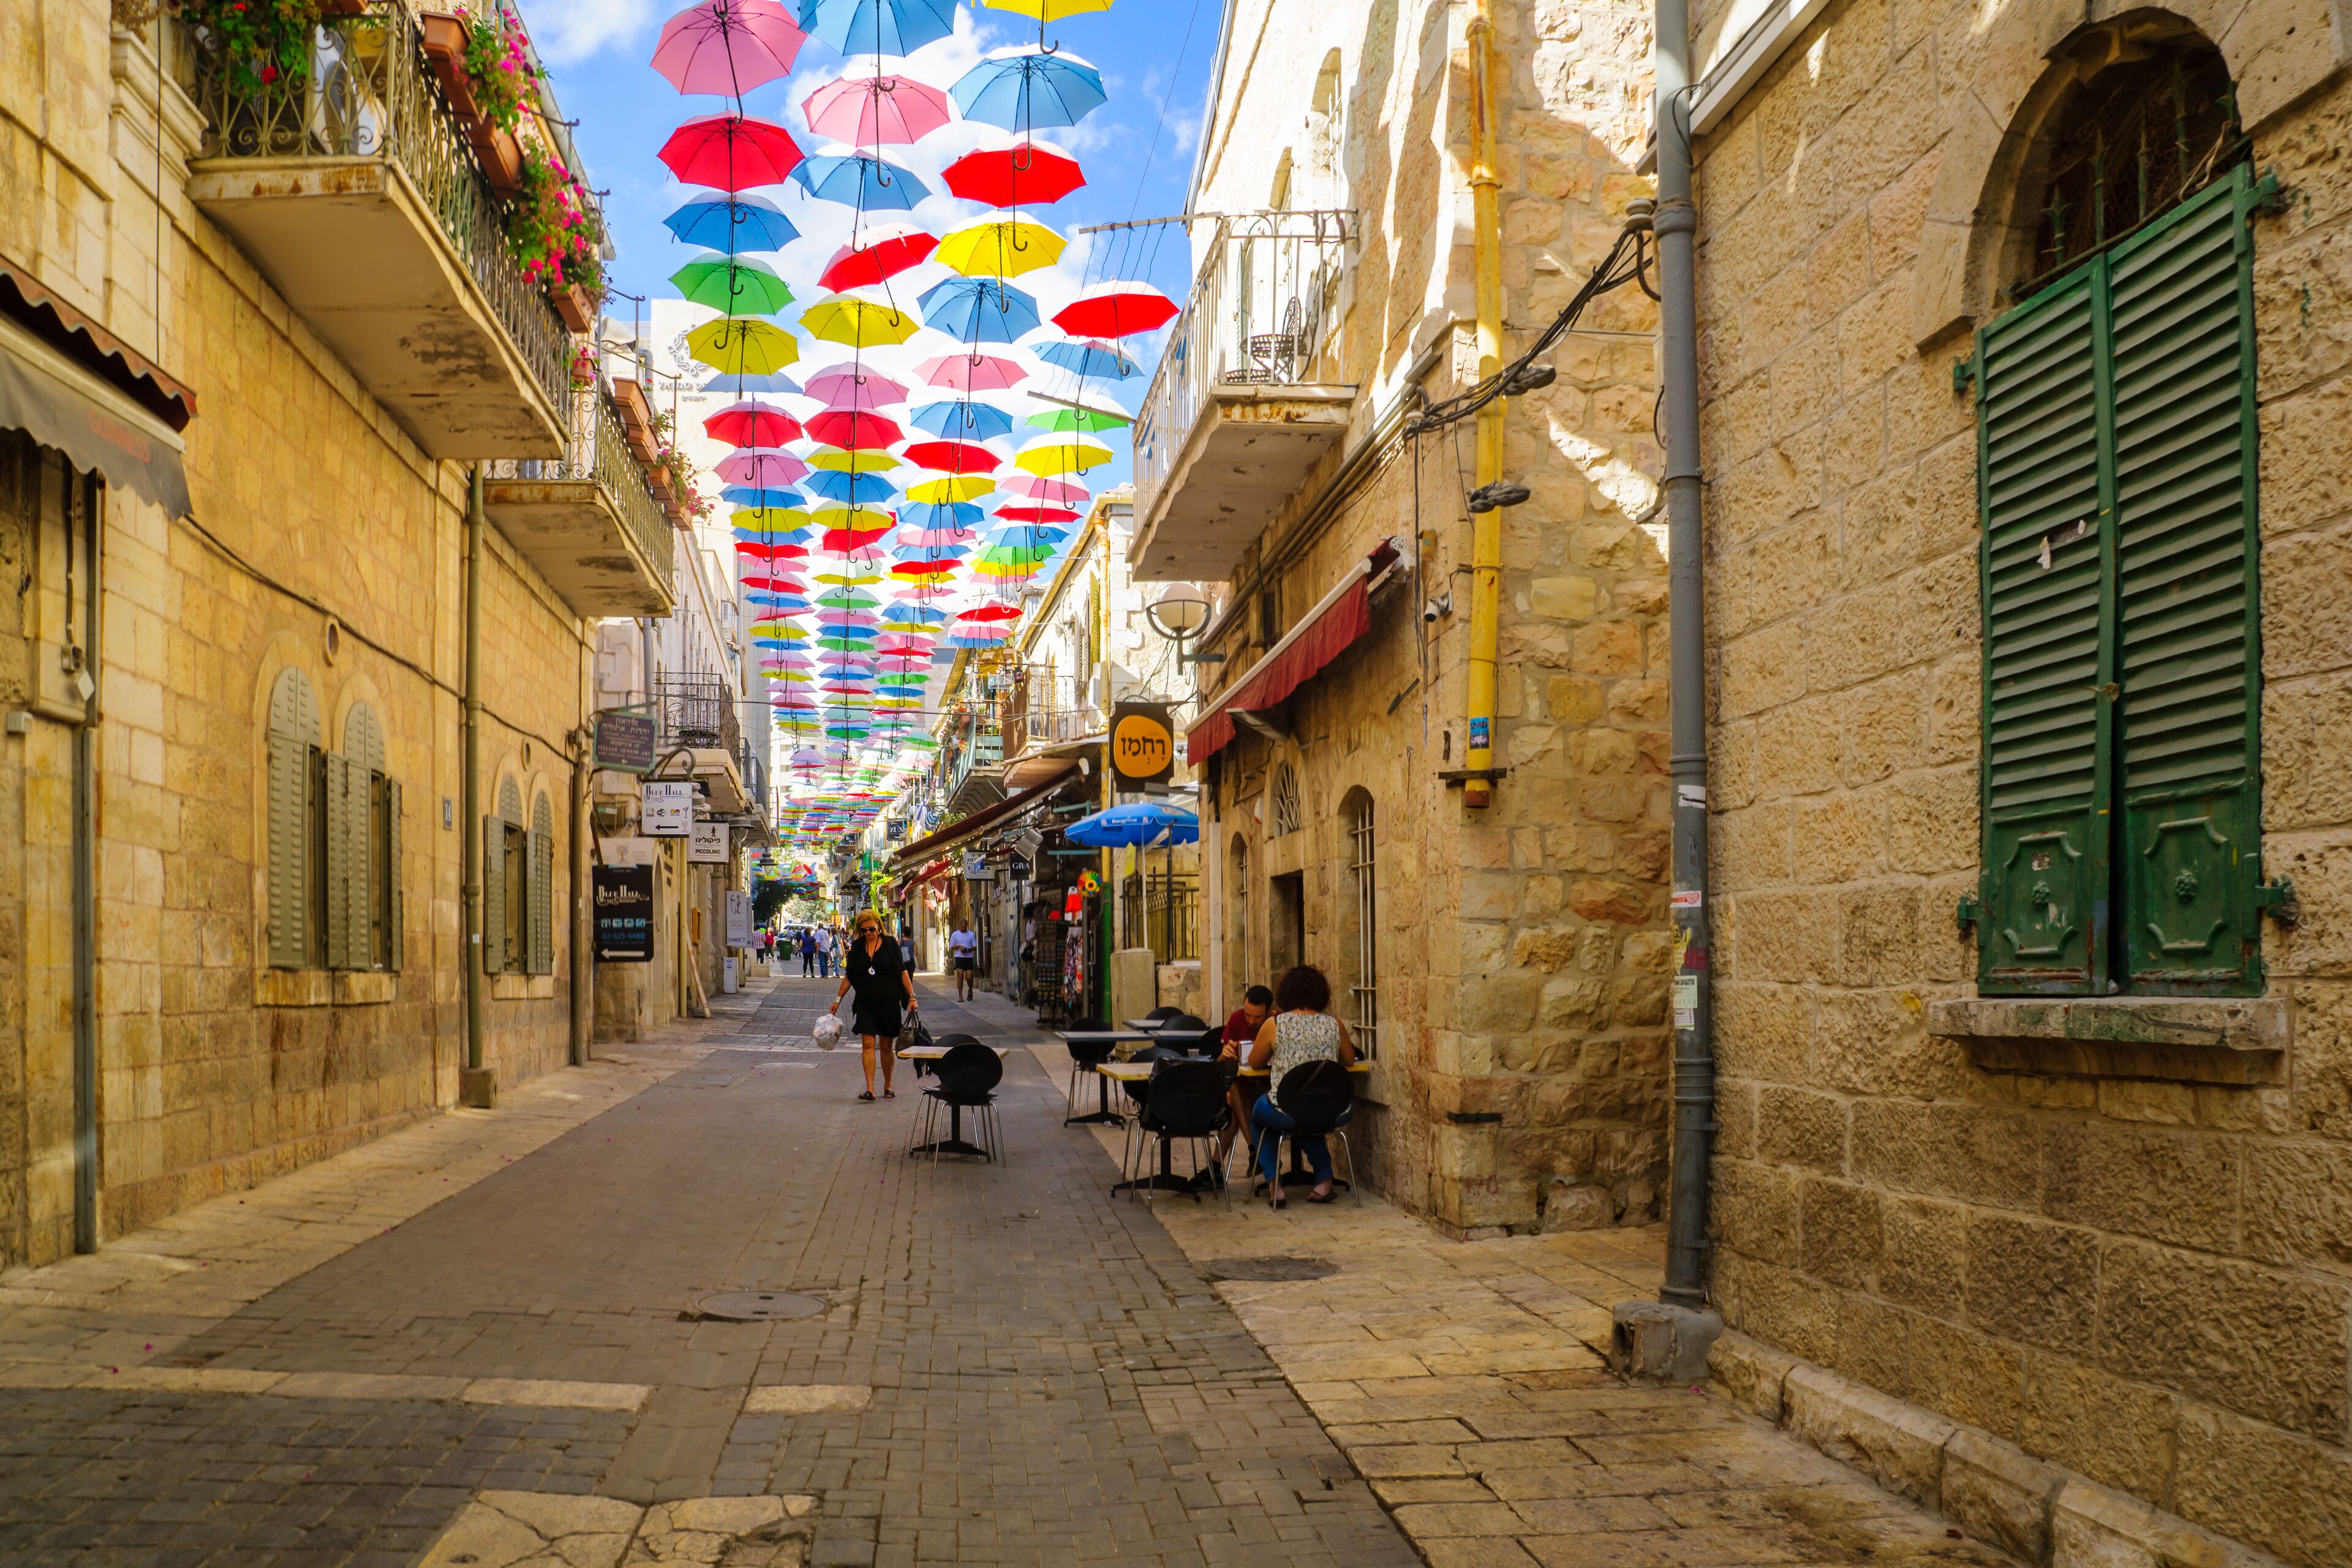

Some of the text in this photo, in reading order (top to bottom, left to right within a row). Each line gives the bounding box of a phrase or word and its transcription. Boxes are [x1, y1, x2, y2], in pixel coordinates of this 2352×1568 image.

[88, 407, 150, 463] GUINNESS
[646, 785, 684, 795] BLUE HALL
[598, 884, 640, 897] BLUE HALL
